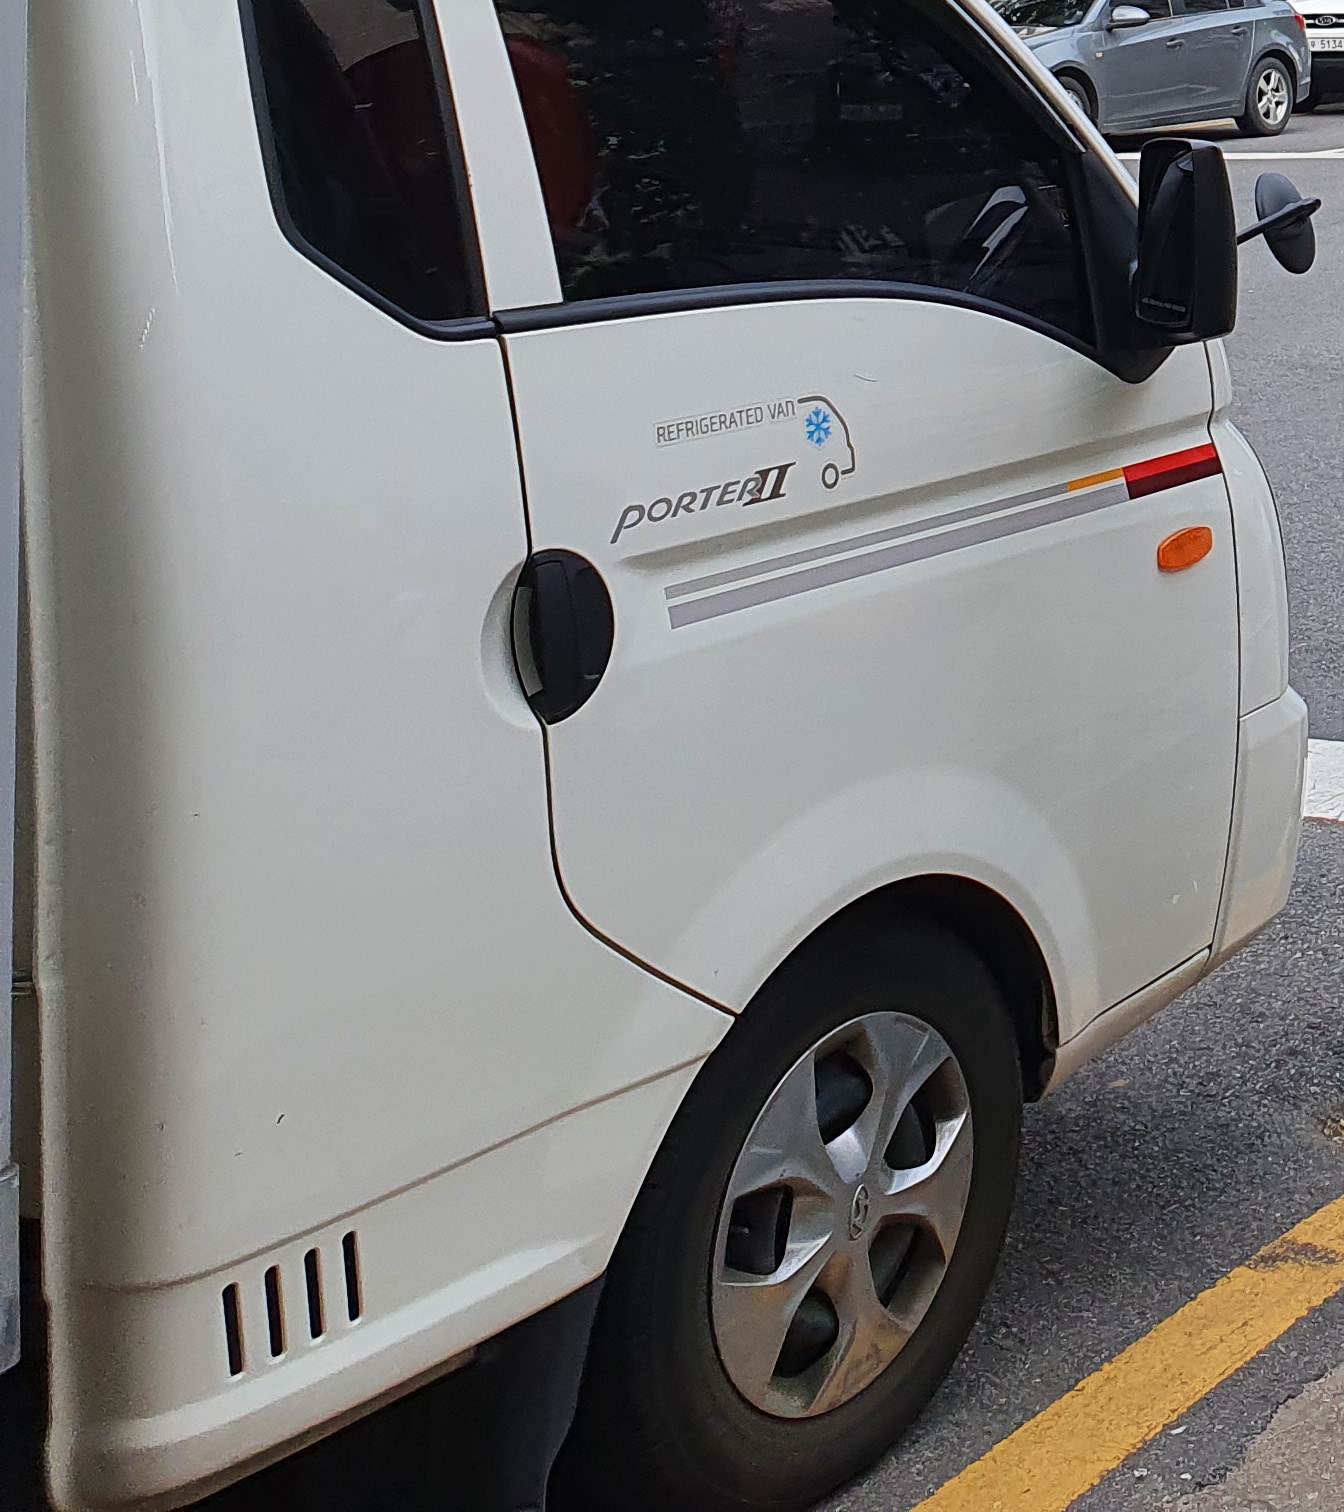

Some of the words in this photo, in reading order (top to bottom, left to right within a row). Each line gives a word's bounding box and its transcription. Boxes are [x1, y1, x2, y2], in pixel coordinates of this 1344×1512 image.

[1320, 39, 1343, 49] 5134
[655, 406, 763, 444] REFRIGERATED
[768, 399, 796, 421] VAN
[611, 472, 762, 544] PORTER
